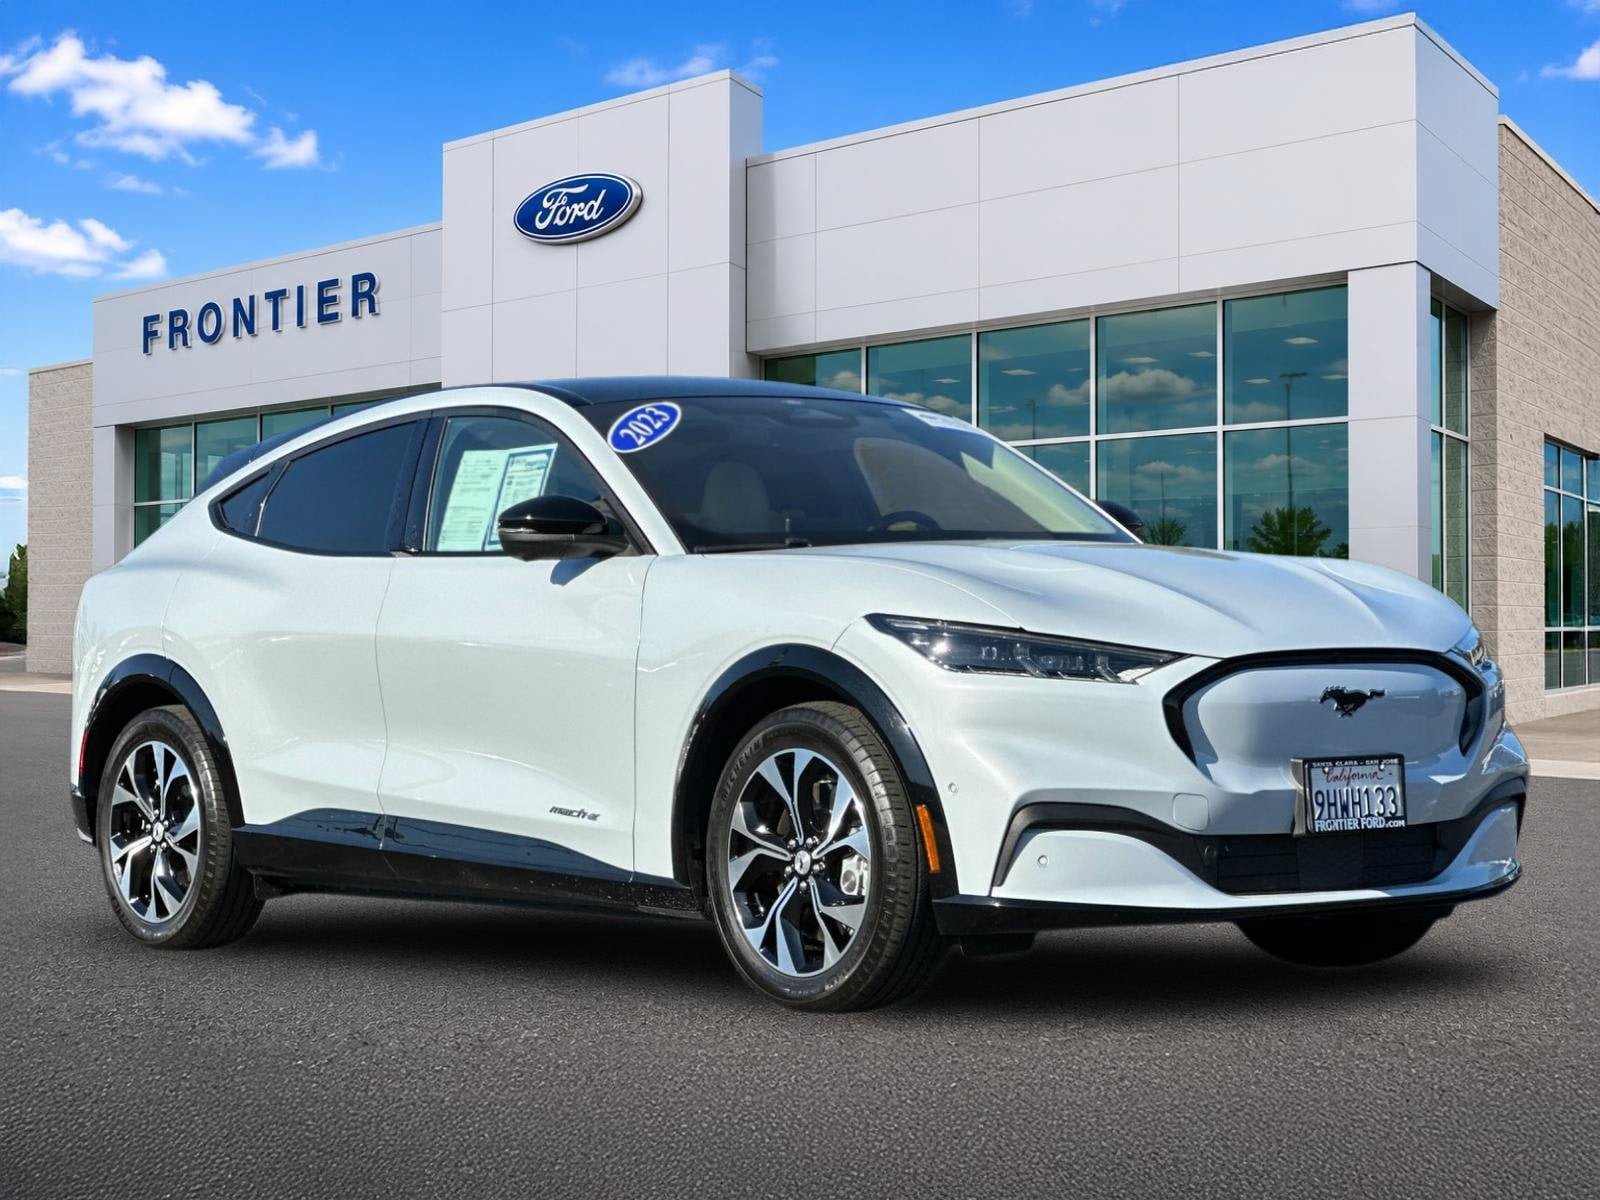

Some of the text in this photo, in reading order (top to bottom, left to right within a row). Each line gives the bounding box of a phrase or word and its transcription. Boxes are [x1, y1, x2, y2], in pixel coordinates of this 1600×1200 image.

[534, 183, 607, 230] Ford
[142, 271, 381, 356] FRONTIER
[619, 407, 670, 446] 2023
[1326, 768, 1384, 786] California
[1314, 786, 1398, 820] 9HWH133
[1315, 818, 1359, 833] FRONTIER
